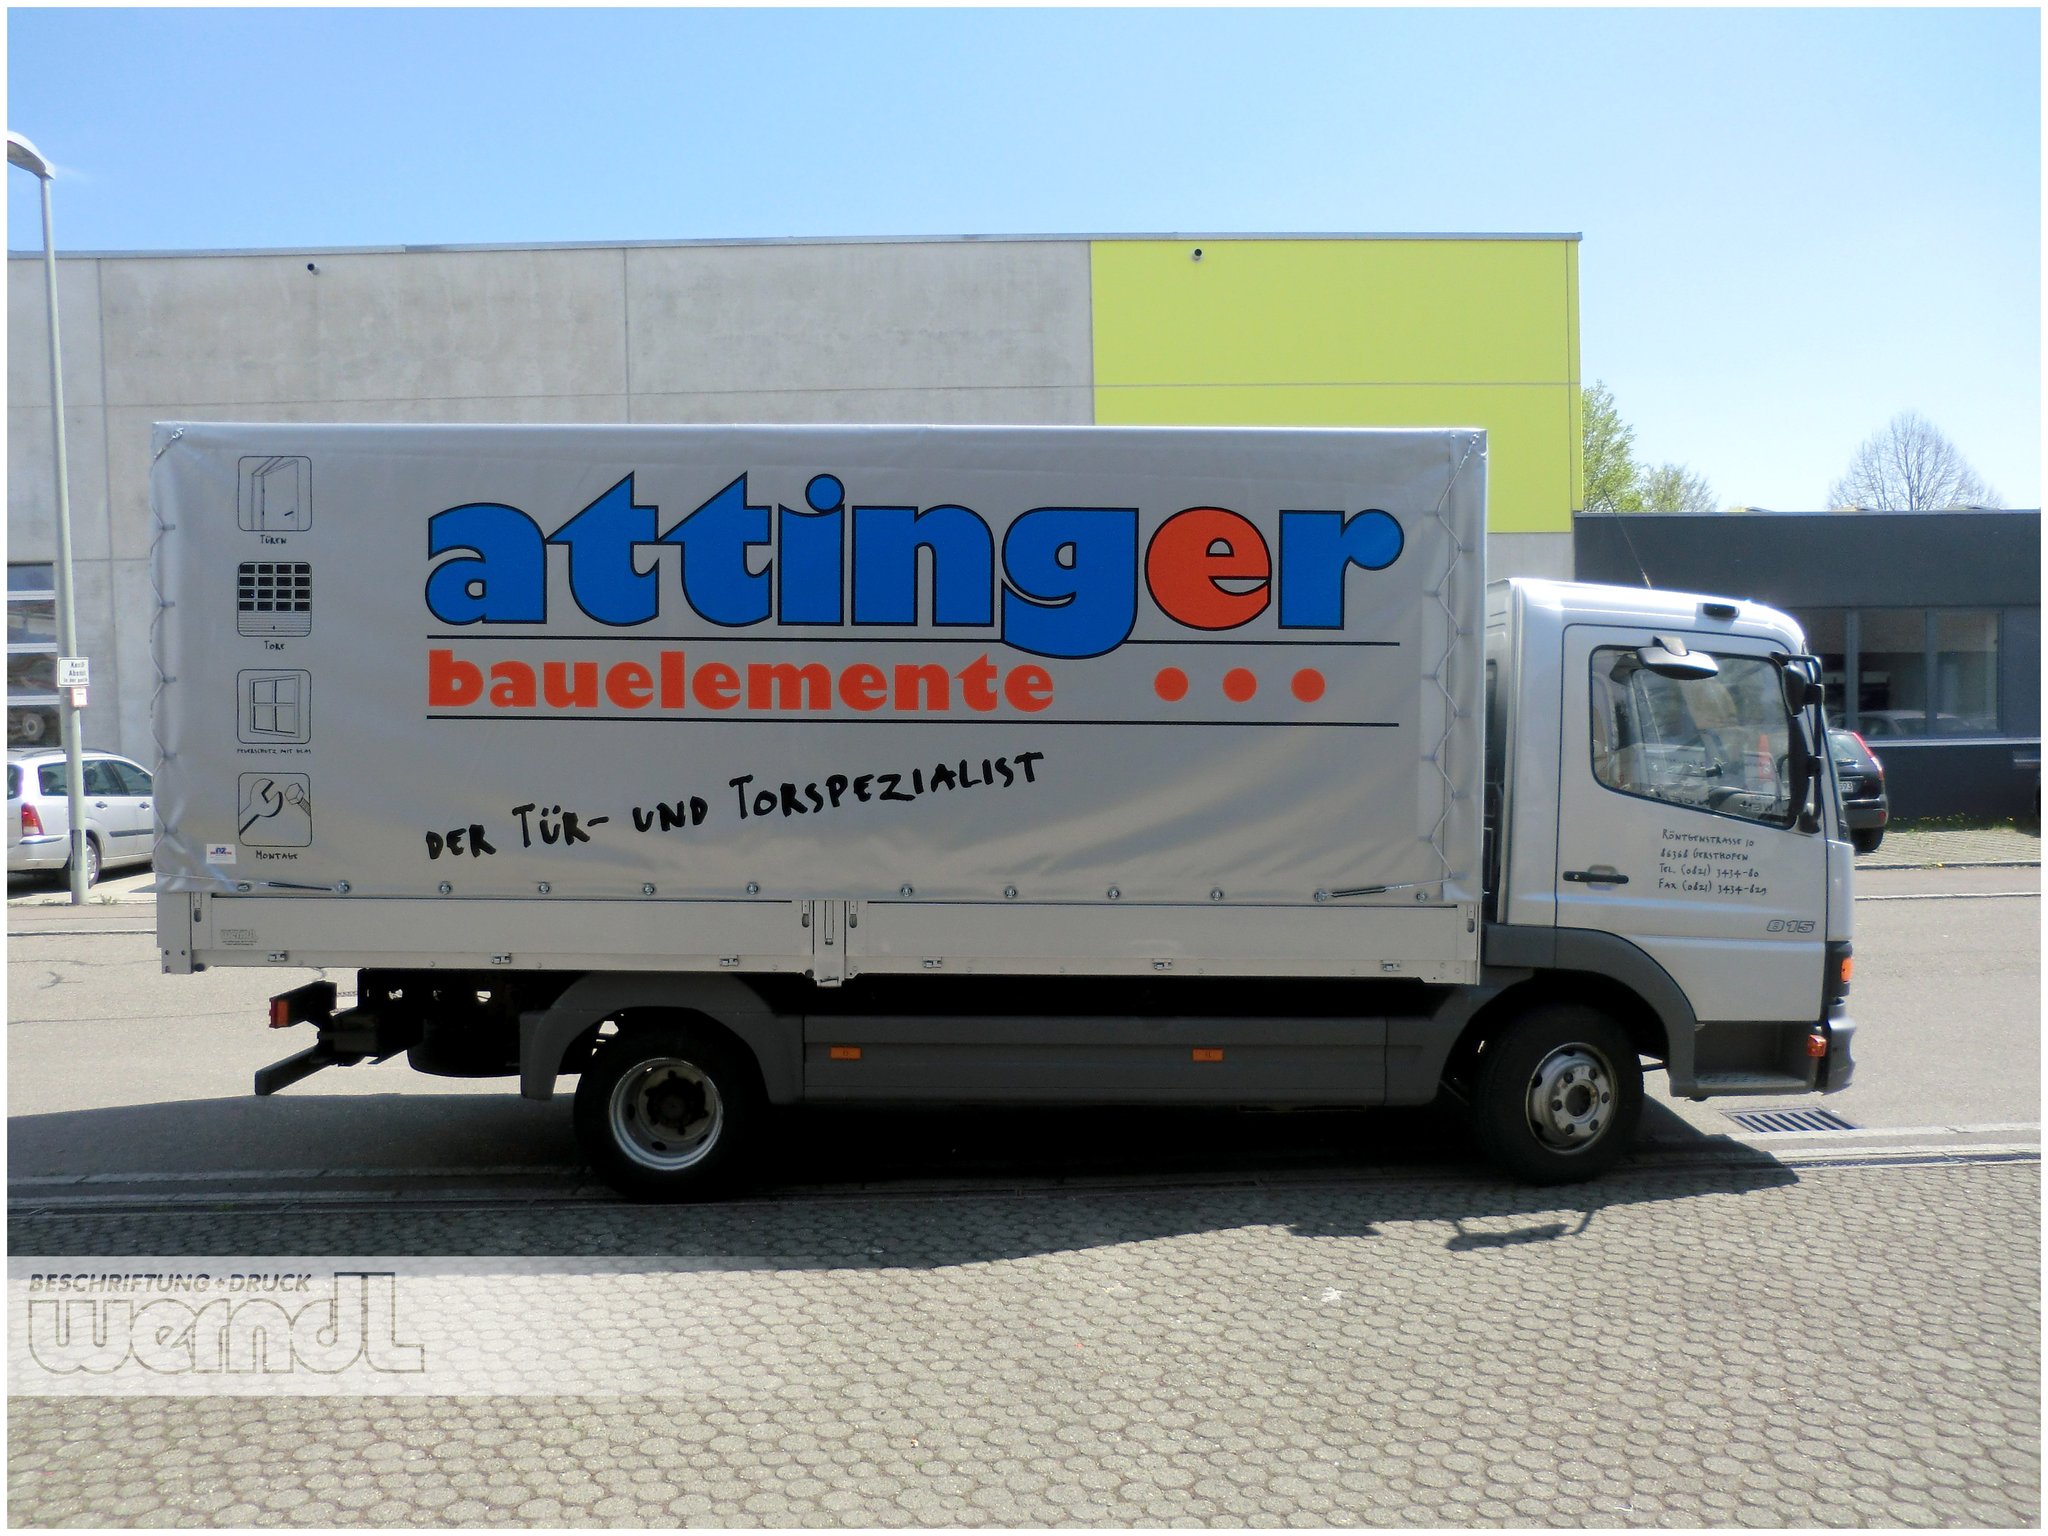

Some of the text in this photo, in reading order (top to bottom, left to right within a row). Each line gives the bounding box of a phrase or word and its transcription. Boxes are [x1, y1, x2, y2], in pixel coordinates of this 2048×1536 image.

[424, 470, 1405, 660] attinger
[427, 649, 1054, 712] bauelemente
[426, 752, 1045, 860] DER TÜR- UND TORSPEZIALIST
[1745, 839, 1755, 847] 10
[1661, 848, 1749, 861] 86368 GERSTHOFEN
[1681, 864, 1711, 876] (0821)
[1716, 868, 1760, 878] 3434-80
[1682, 880, 1712, 892] (0821)
[1766, 919, 1816, 933] 815
